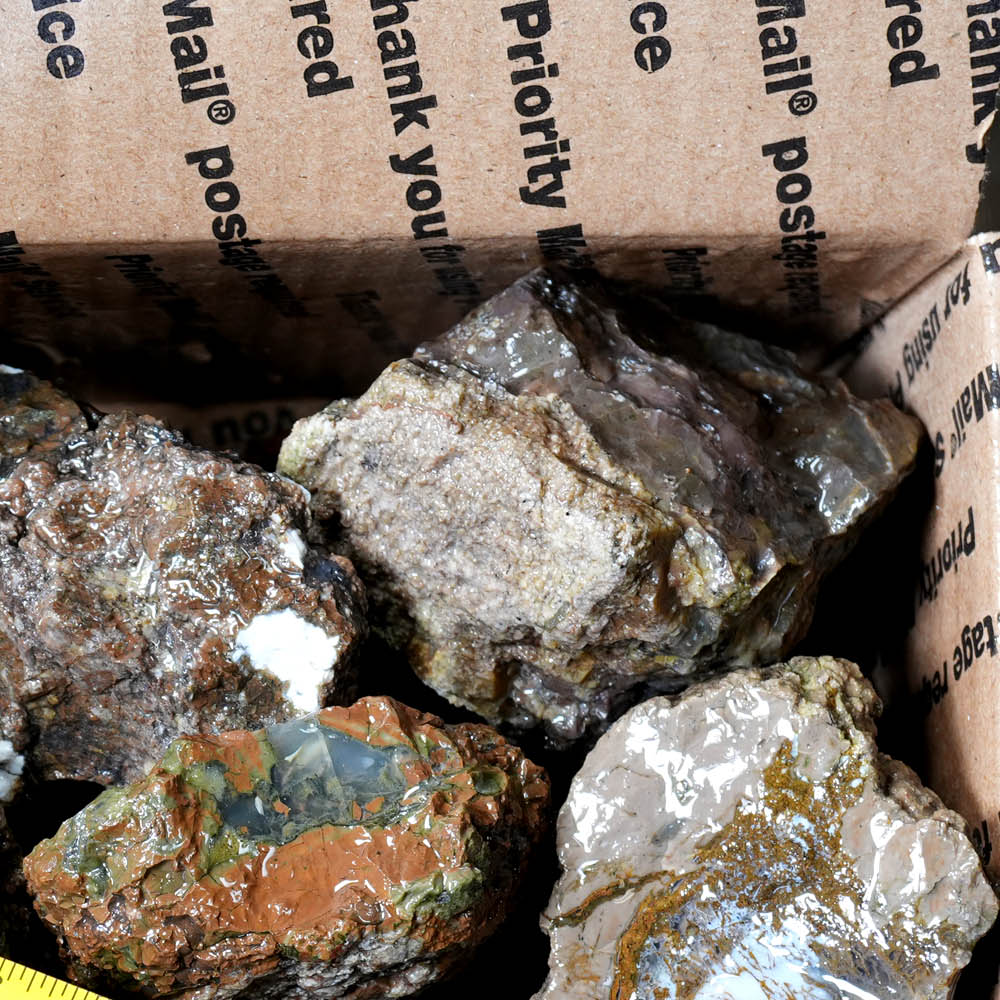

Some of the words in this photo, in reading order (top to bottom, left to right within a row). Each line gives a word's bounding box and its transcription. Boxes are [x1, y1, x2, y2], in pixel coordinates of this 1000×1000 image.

[500, 0, 571, 208] Priority
[389, 144, 449, 240] you
[943, 260, 972, 324] for
[952, 612, 1000, 682] tage
